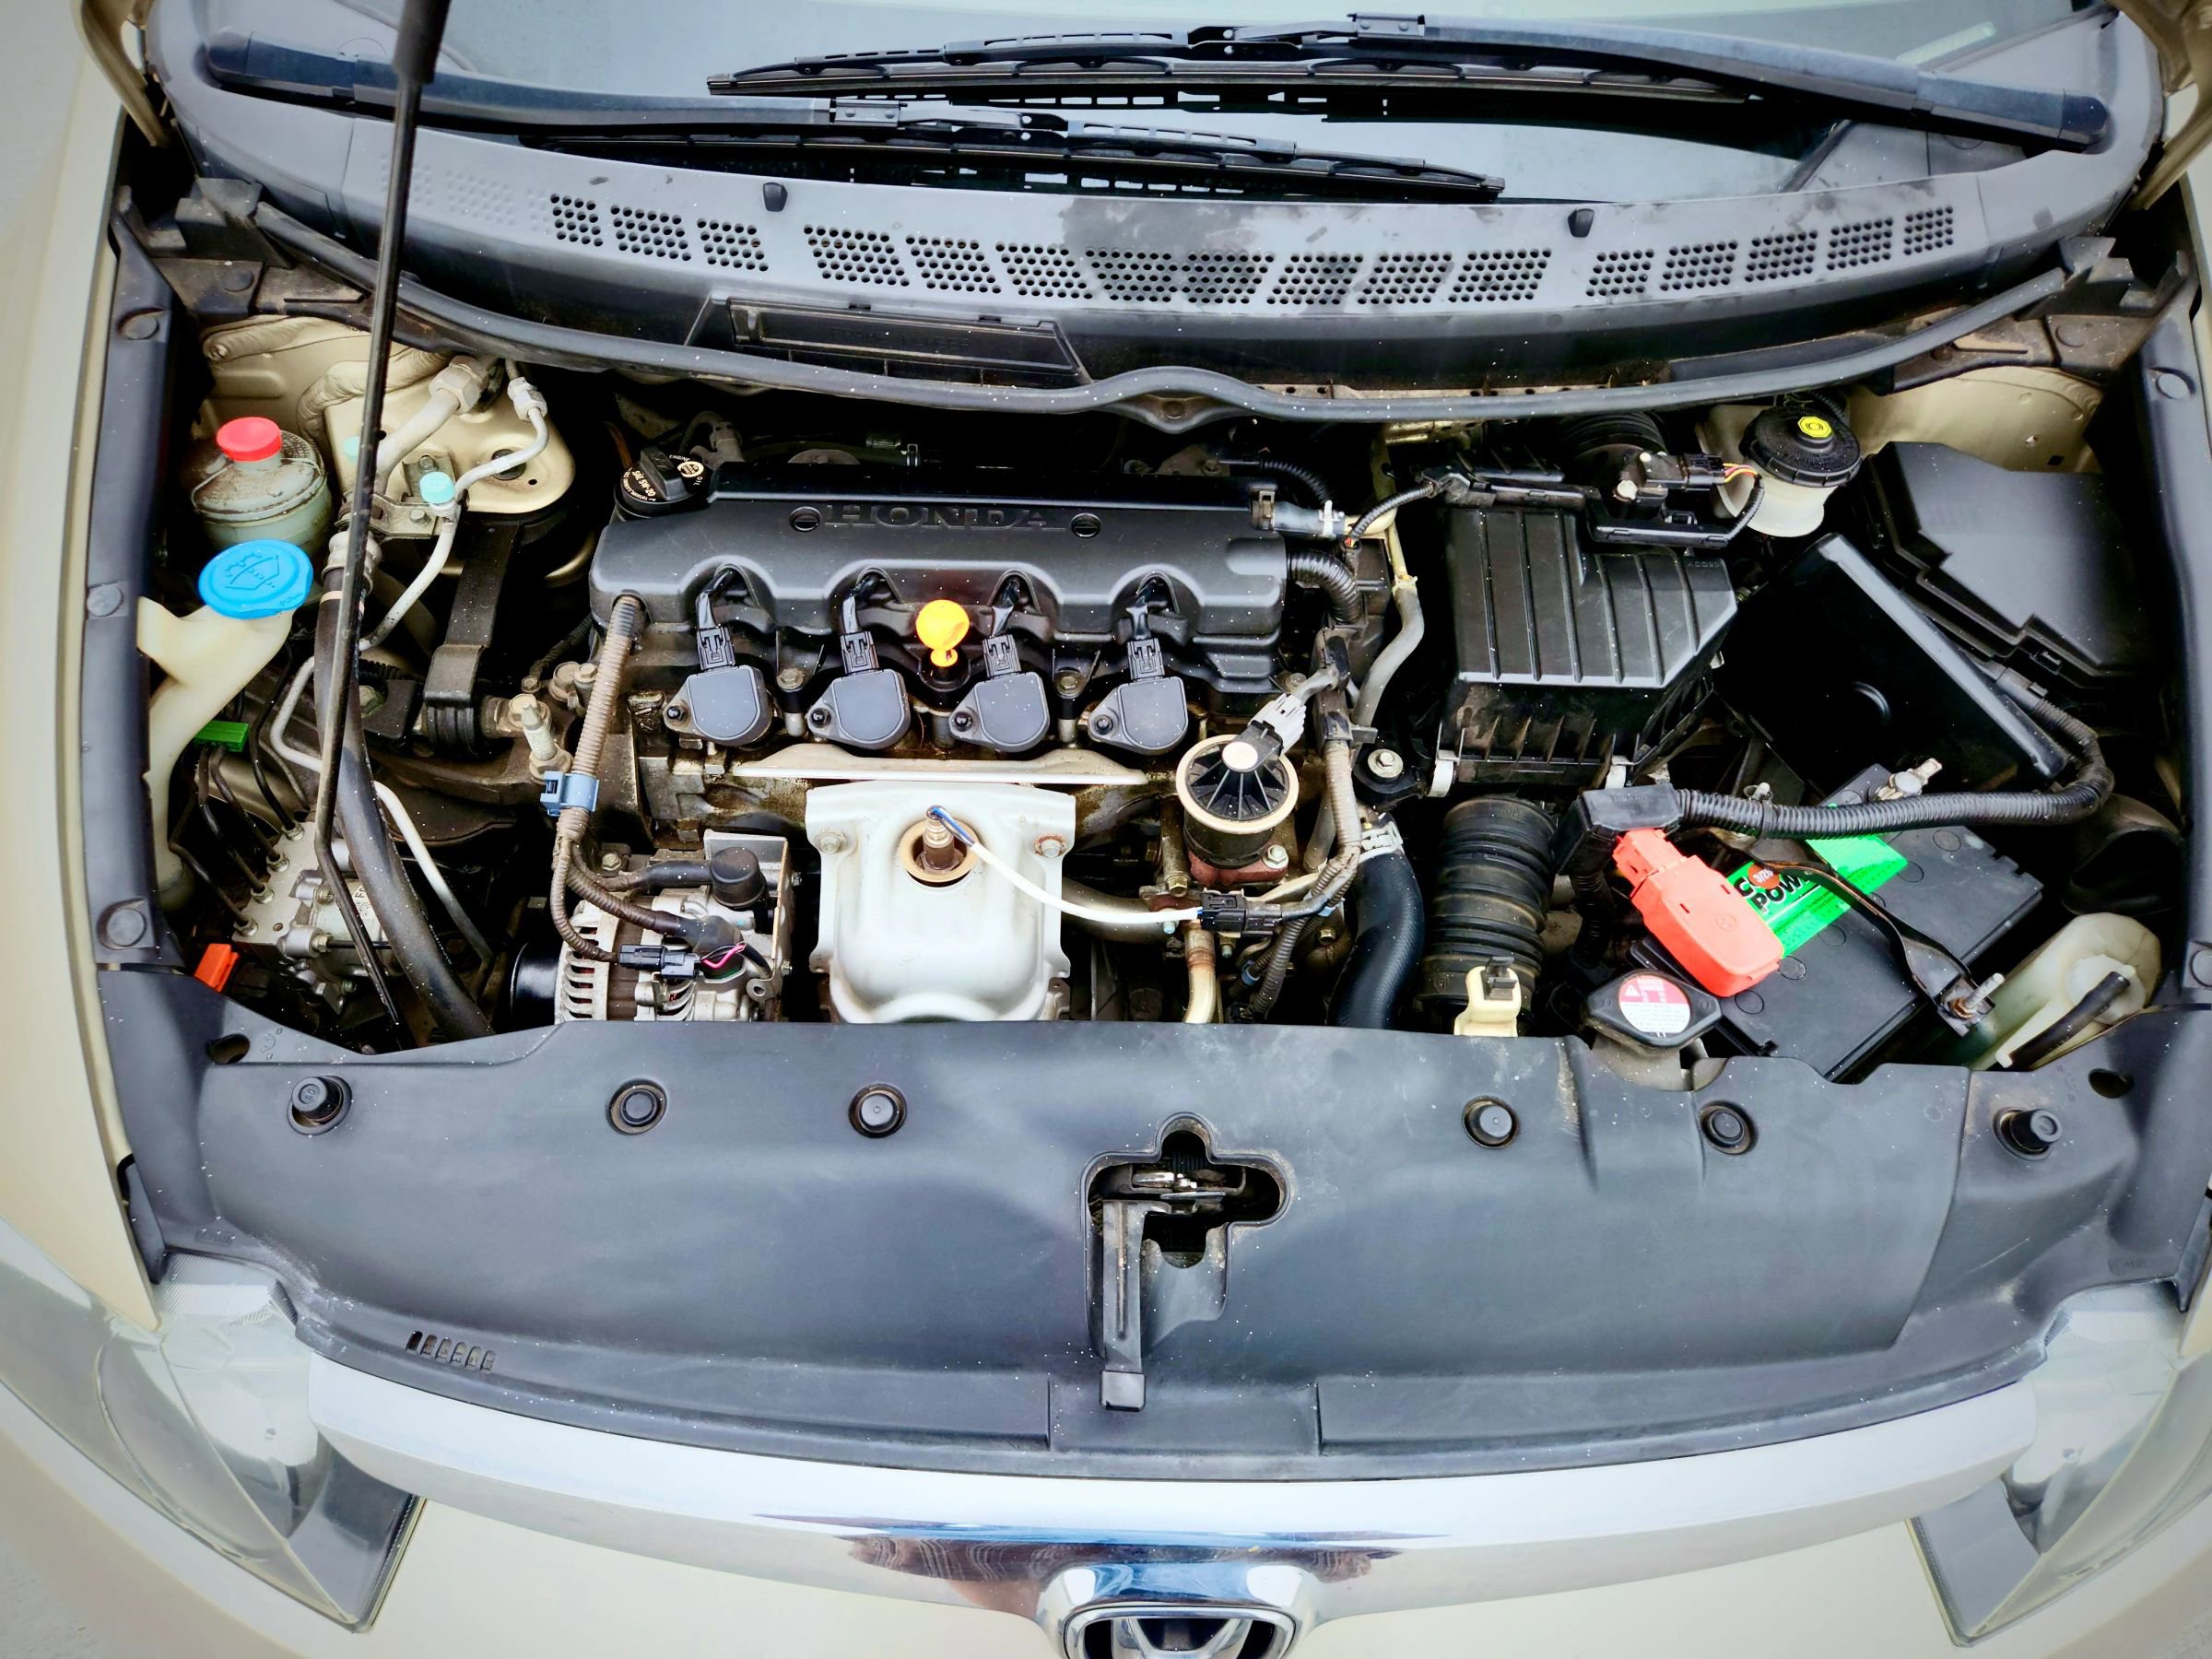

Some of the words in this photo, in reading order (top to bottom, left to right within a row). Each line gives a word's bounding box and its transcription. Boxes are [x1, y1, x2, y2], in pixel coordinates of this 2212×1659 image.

[631, 470, 644, 481] SAE
[639, 478, 656, 497] 5W-20
[693, 476, 703, 486] OIL
[824, 503, 1066, 531] HONDA
